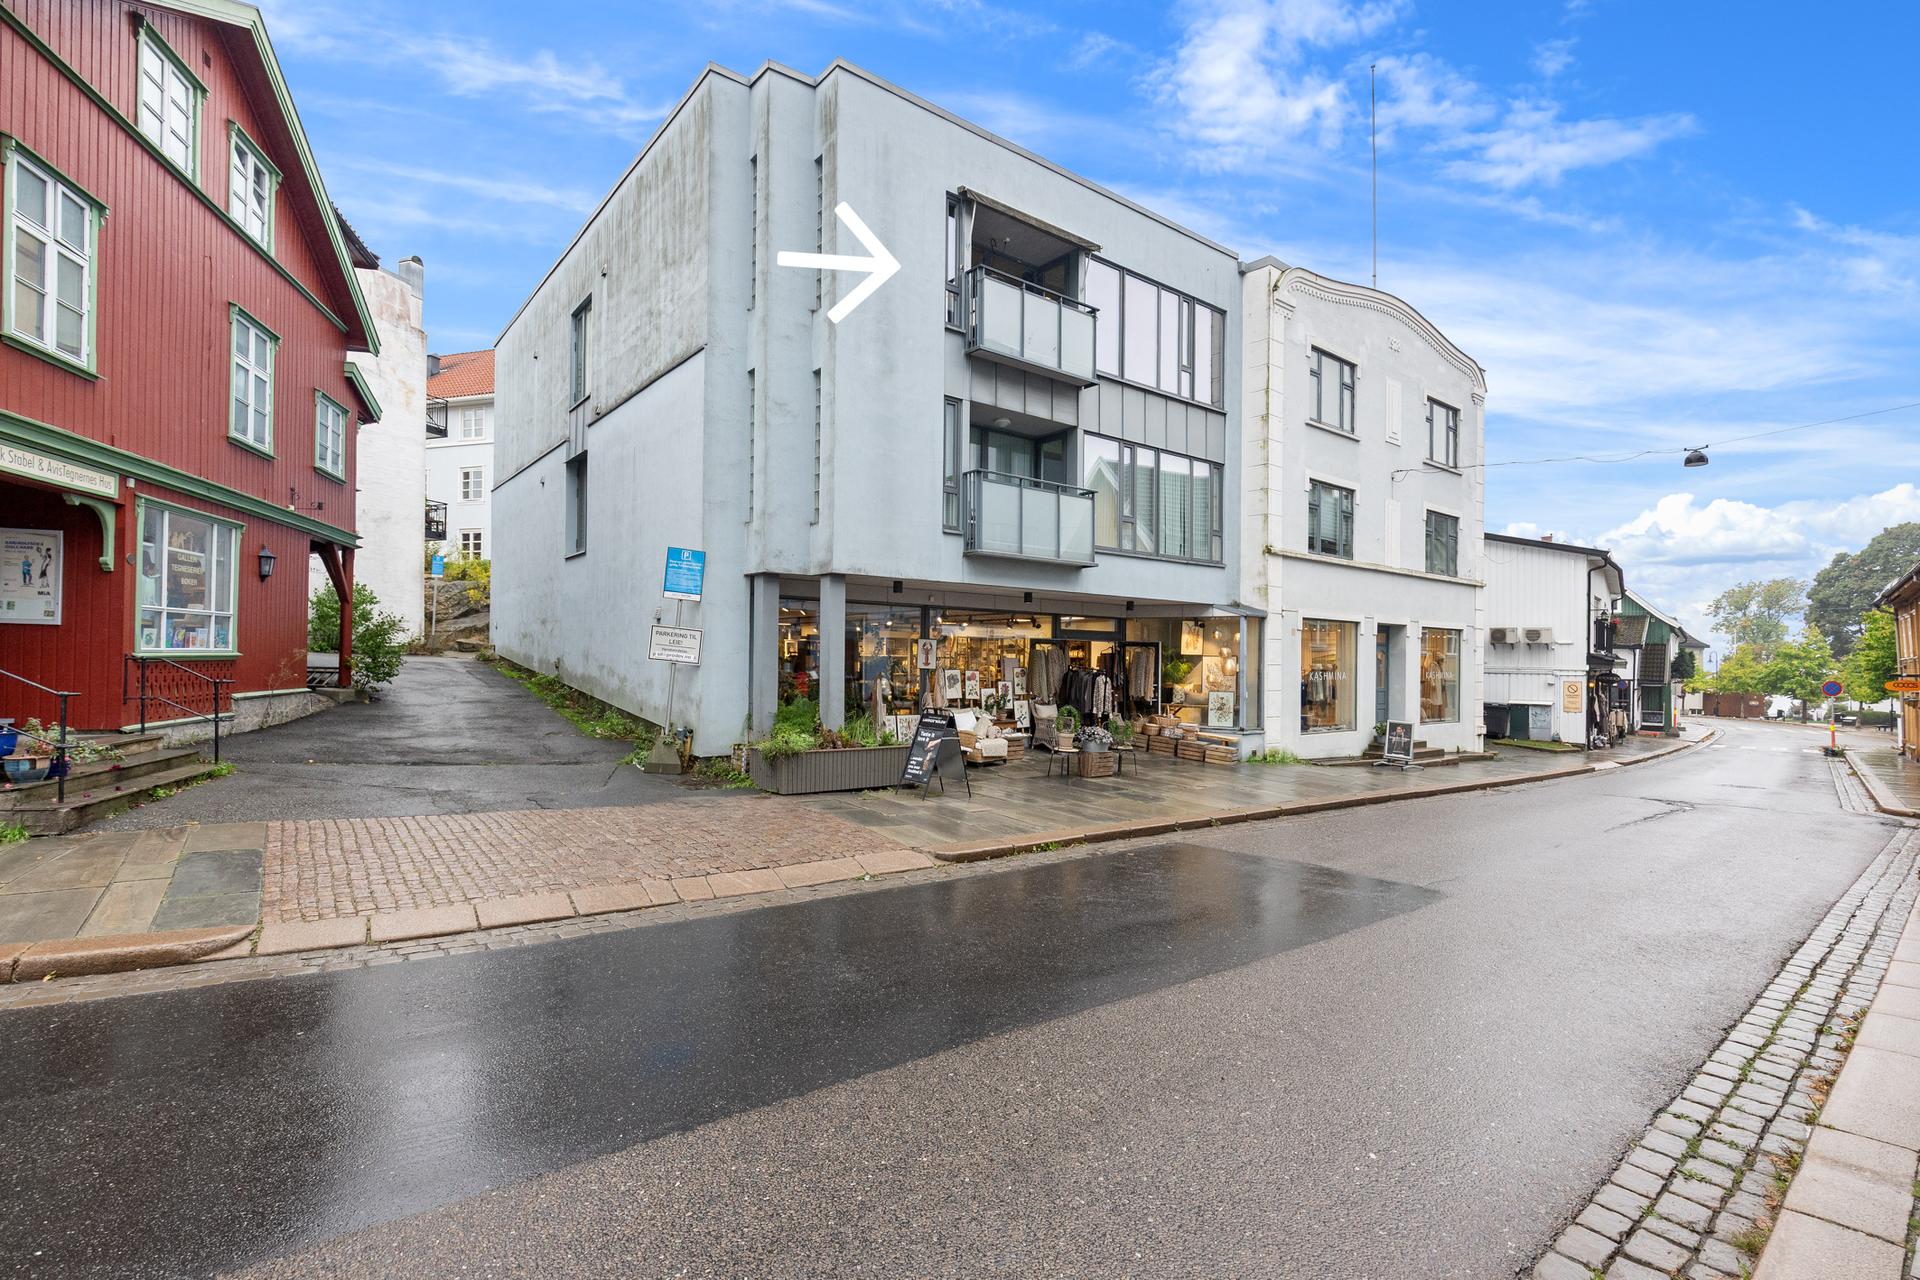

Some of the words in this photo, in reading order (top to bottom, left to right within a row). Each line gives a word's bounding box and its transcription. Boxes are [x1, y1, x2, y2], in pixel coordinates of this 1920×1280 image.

[8, 449, 35, 469] Stabel
[37, 458, 44, 472] &
[99, 475, 112, 490] Hus
[655, 630, 688, 639] PARKERING
[1309, 671, 1347, 681] KASHMINA
